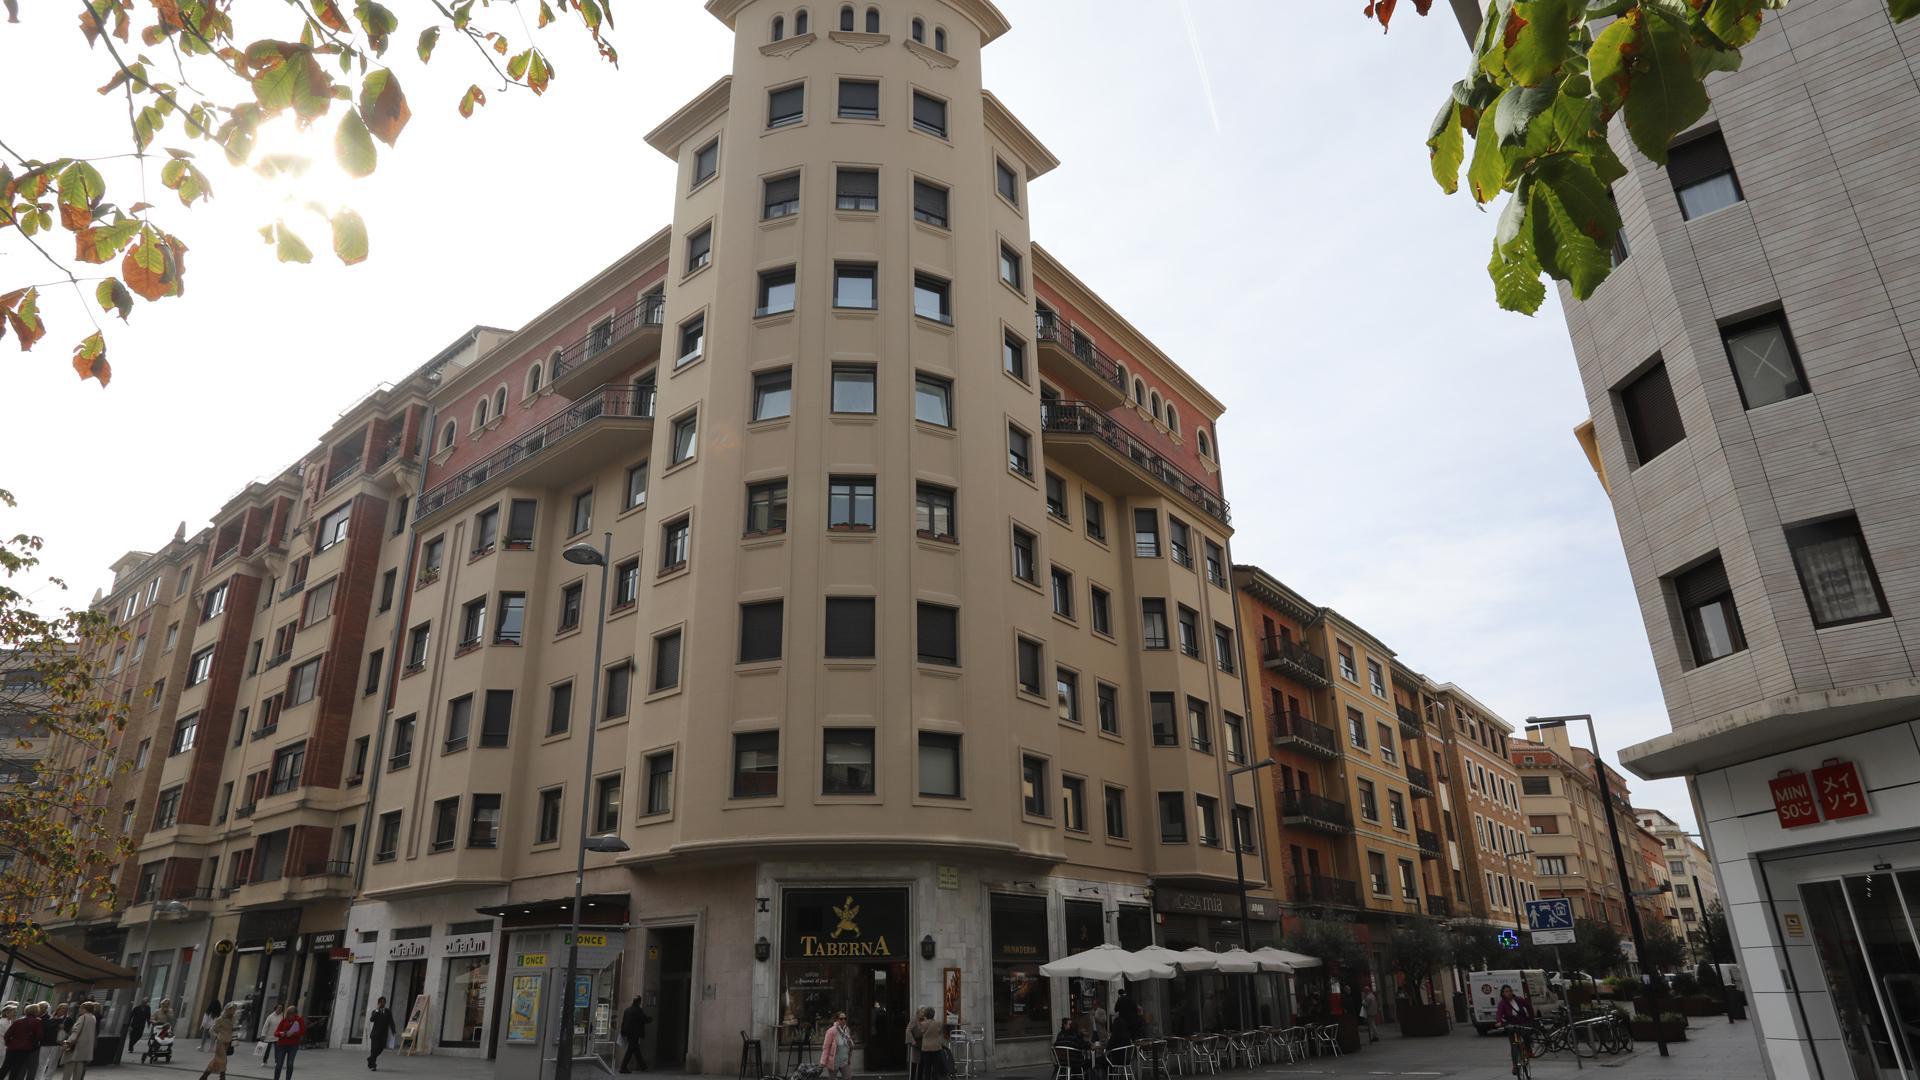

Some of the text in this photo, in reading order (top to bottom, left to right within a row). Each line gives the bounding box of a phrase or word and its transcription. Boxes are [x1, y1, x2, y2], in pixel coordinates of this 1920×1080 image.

[1823, 772, 1849, 794] メイ
[1775, 784, 1808, 802] MINI
[1827, 791, 1858, 811] ソウ
[576, 935, 603, 945] ONCE
[800, 935, 891, 957] TABERNA
[525, 955, 544, 965] ONCE
